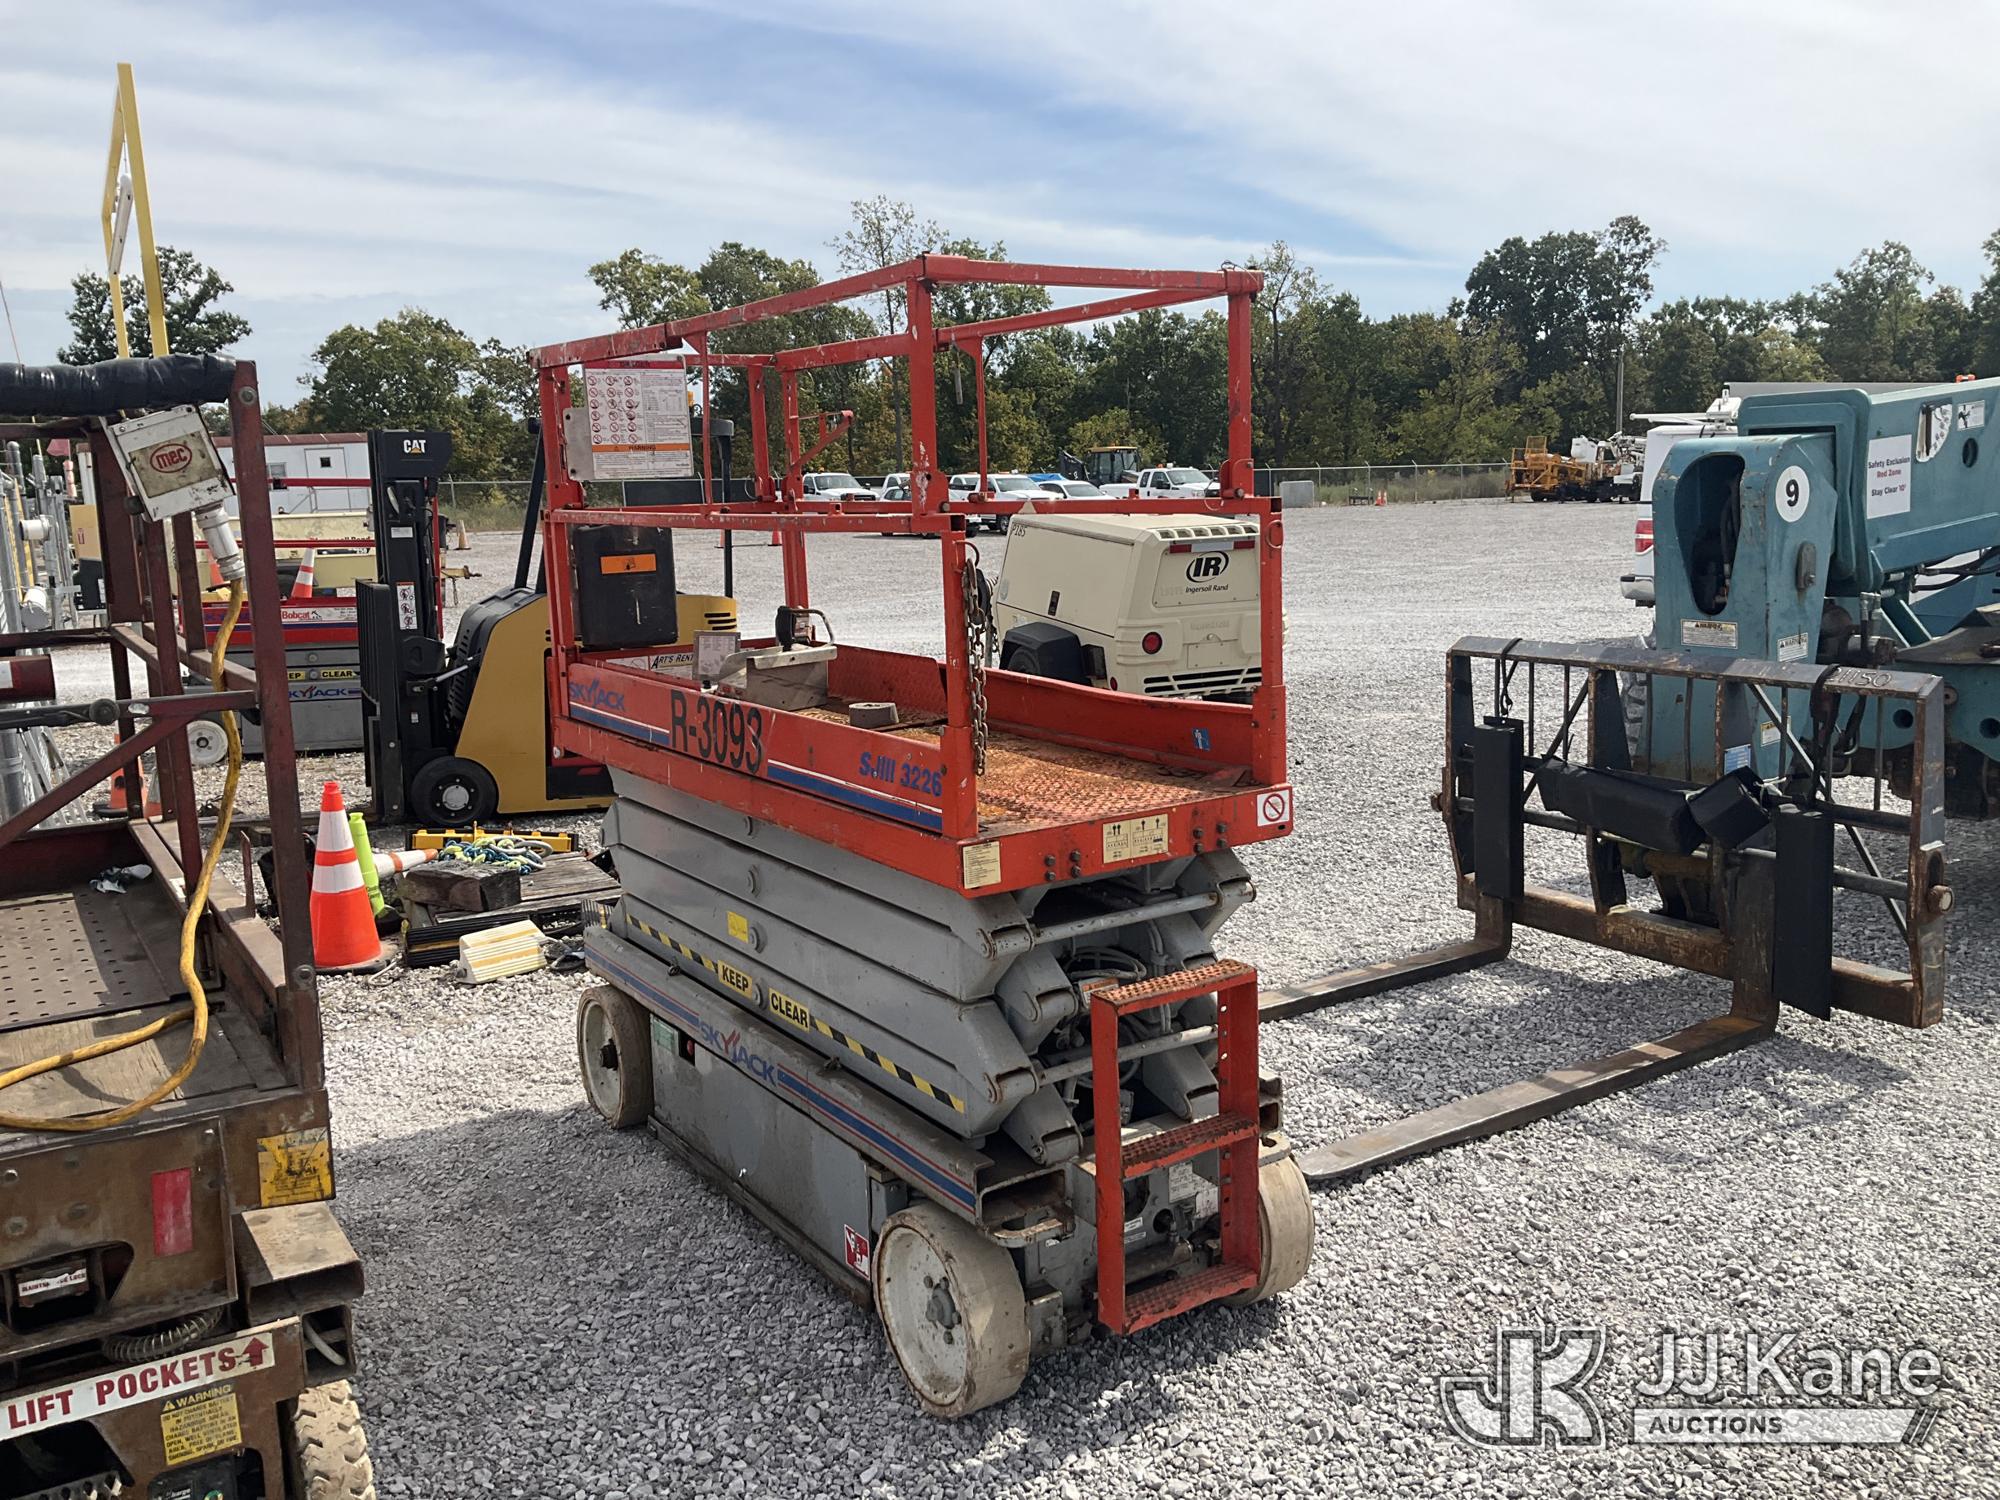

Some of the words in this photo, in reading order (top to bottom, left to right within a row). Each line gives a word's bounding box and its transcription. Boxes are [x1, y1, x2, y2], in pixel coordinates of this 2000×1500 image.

[403, 439, 426, 454] CAT
[1785, 478, 1800, 507] 9
[1193, 556, 1222, 578] IR
[1185, 584, 1212, 595] Ingersoll
[1213, 583, 1229, 592] Rand
[282, 610, 310, 620] Bobcat
[322, 670, 353, 678] CLEAR
[288, 685, 347, 698] KYJACK
[670, 688, 763, 775] R-3093
[900, 762, 943, 798] 3226
[722, 964, 749, 992] KEEP
[770, 992, 809, 1029] CLEAR
[700, 1020, 778, 1088] SKYJACK
[8, 1389, 73, 1430] LIFT
[95, 1347, 237, 1406] POCKETS
[176, 1384, 231, 1407] WARNING
